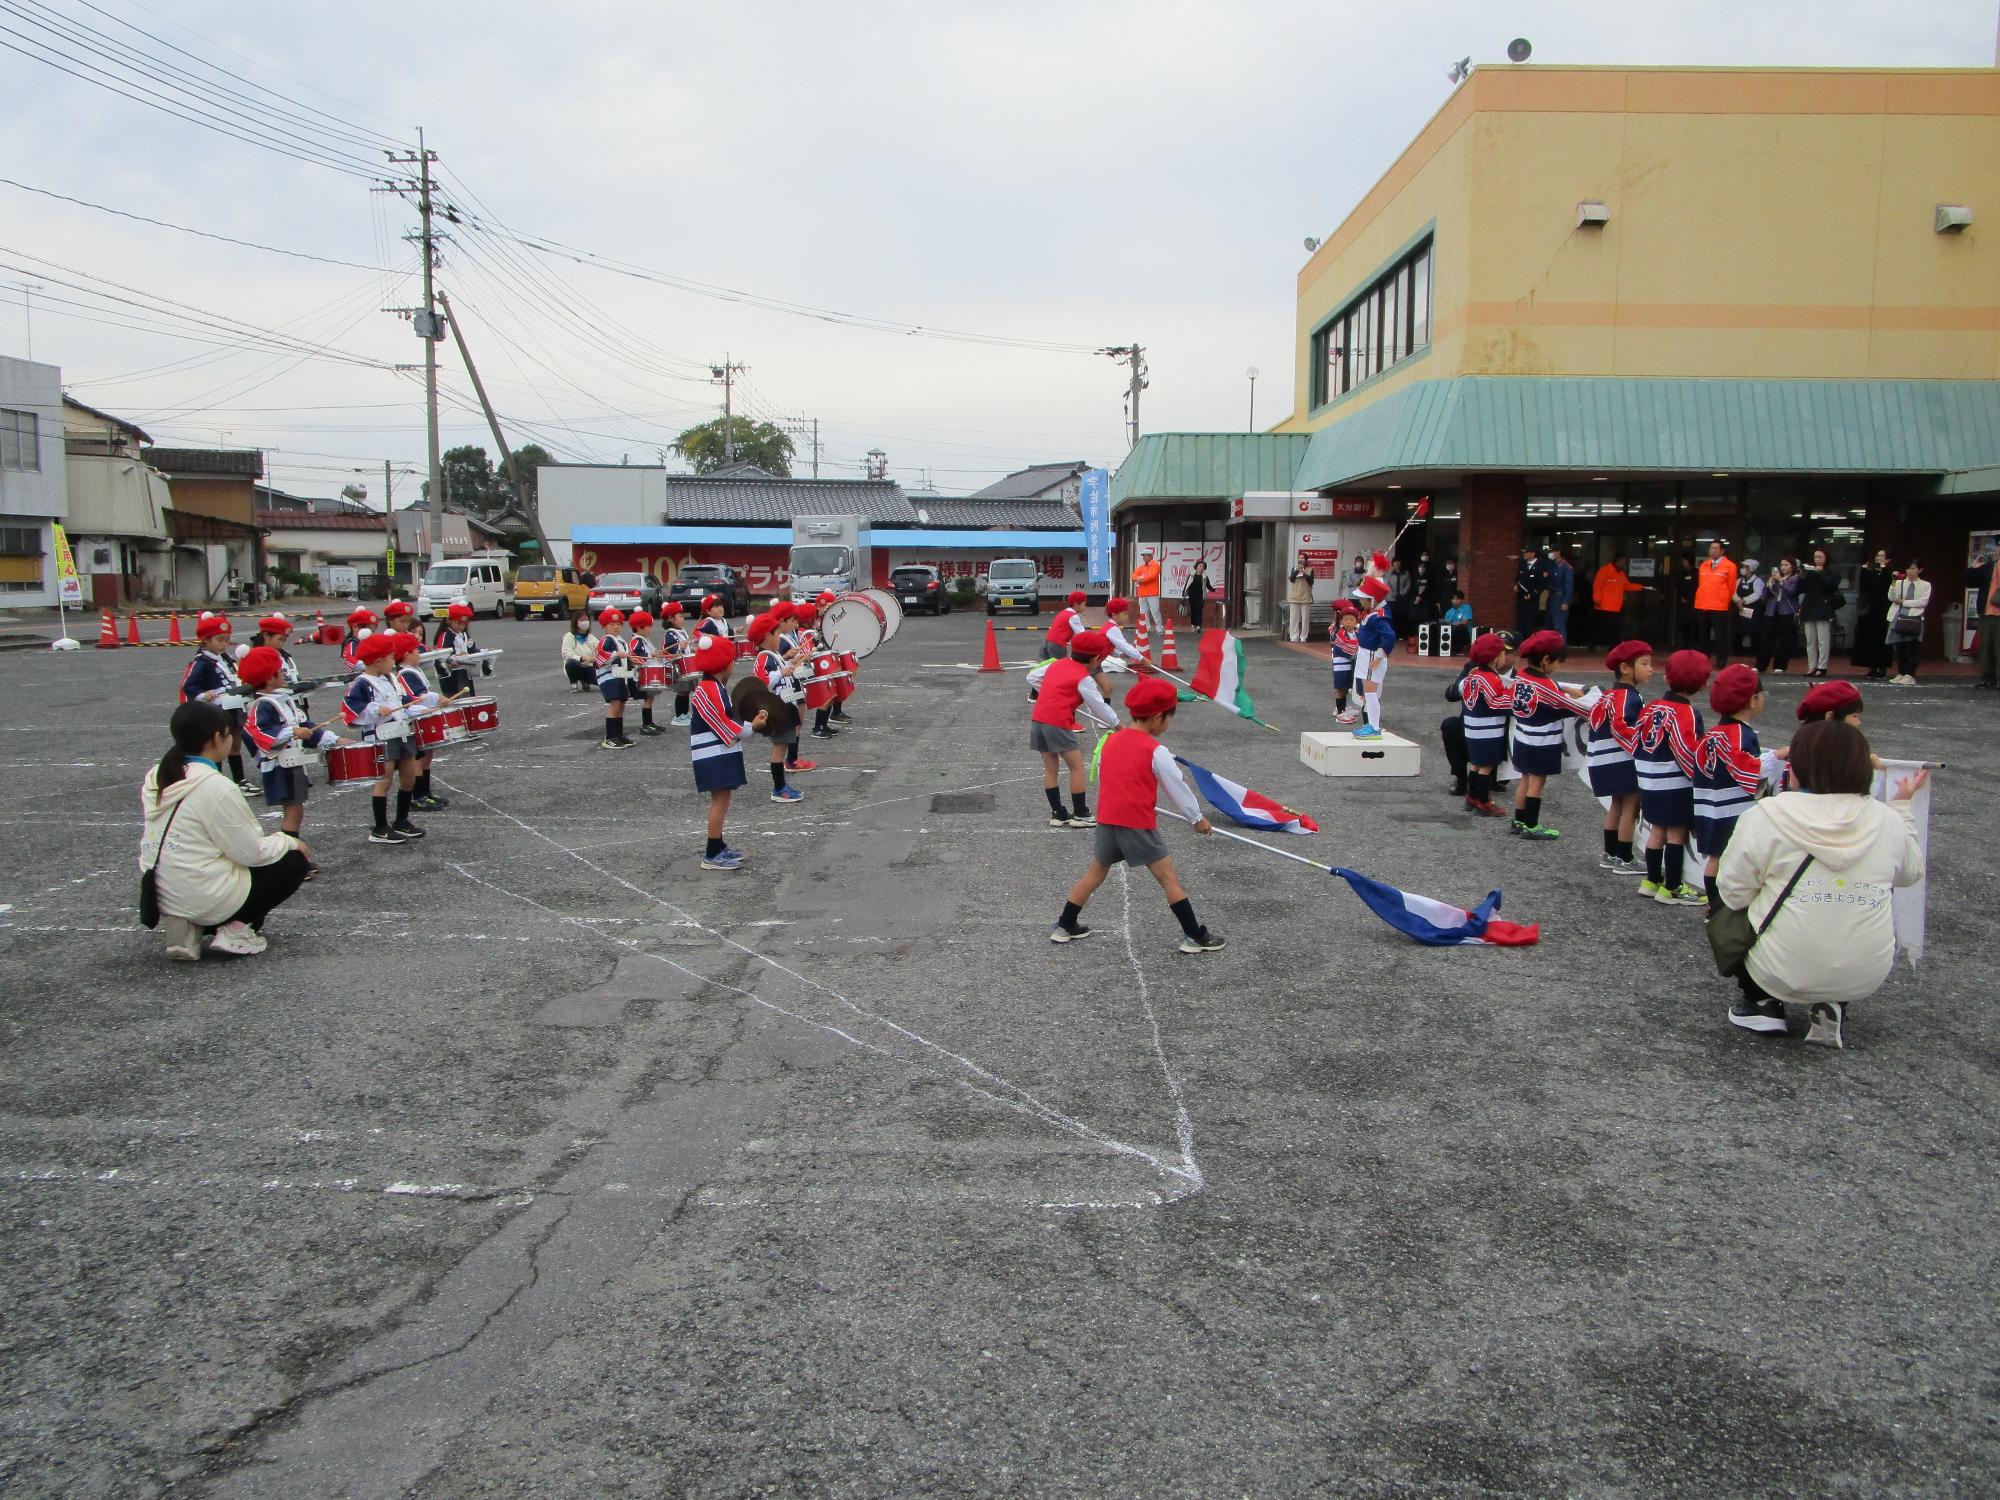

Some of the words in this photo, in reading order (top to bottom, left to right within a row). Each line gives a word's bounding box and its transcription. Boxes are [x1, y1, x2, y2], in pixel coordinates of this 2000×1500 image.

[1789, 892, 1883, 910] ことぶきようちえん
